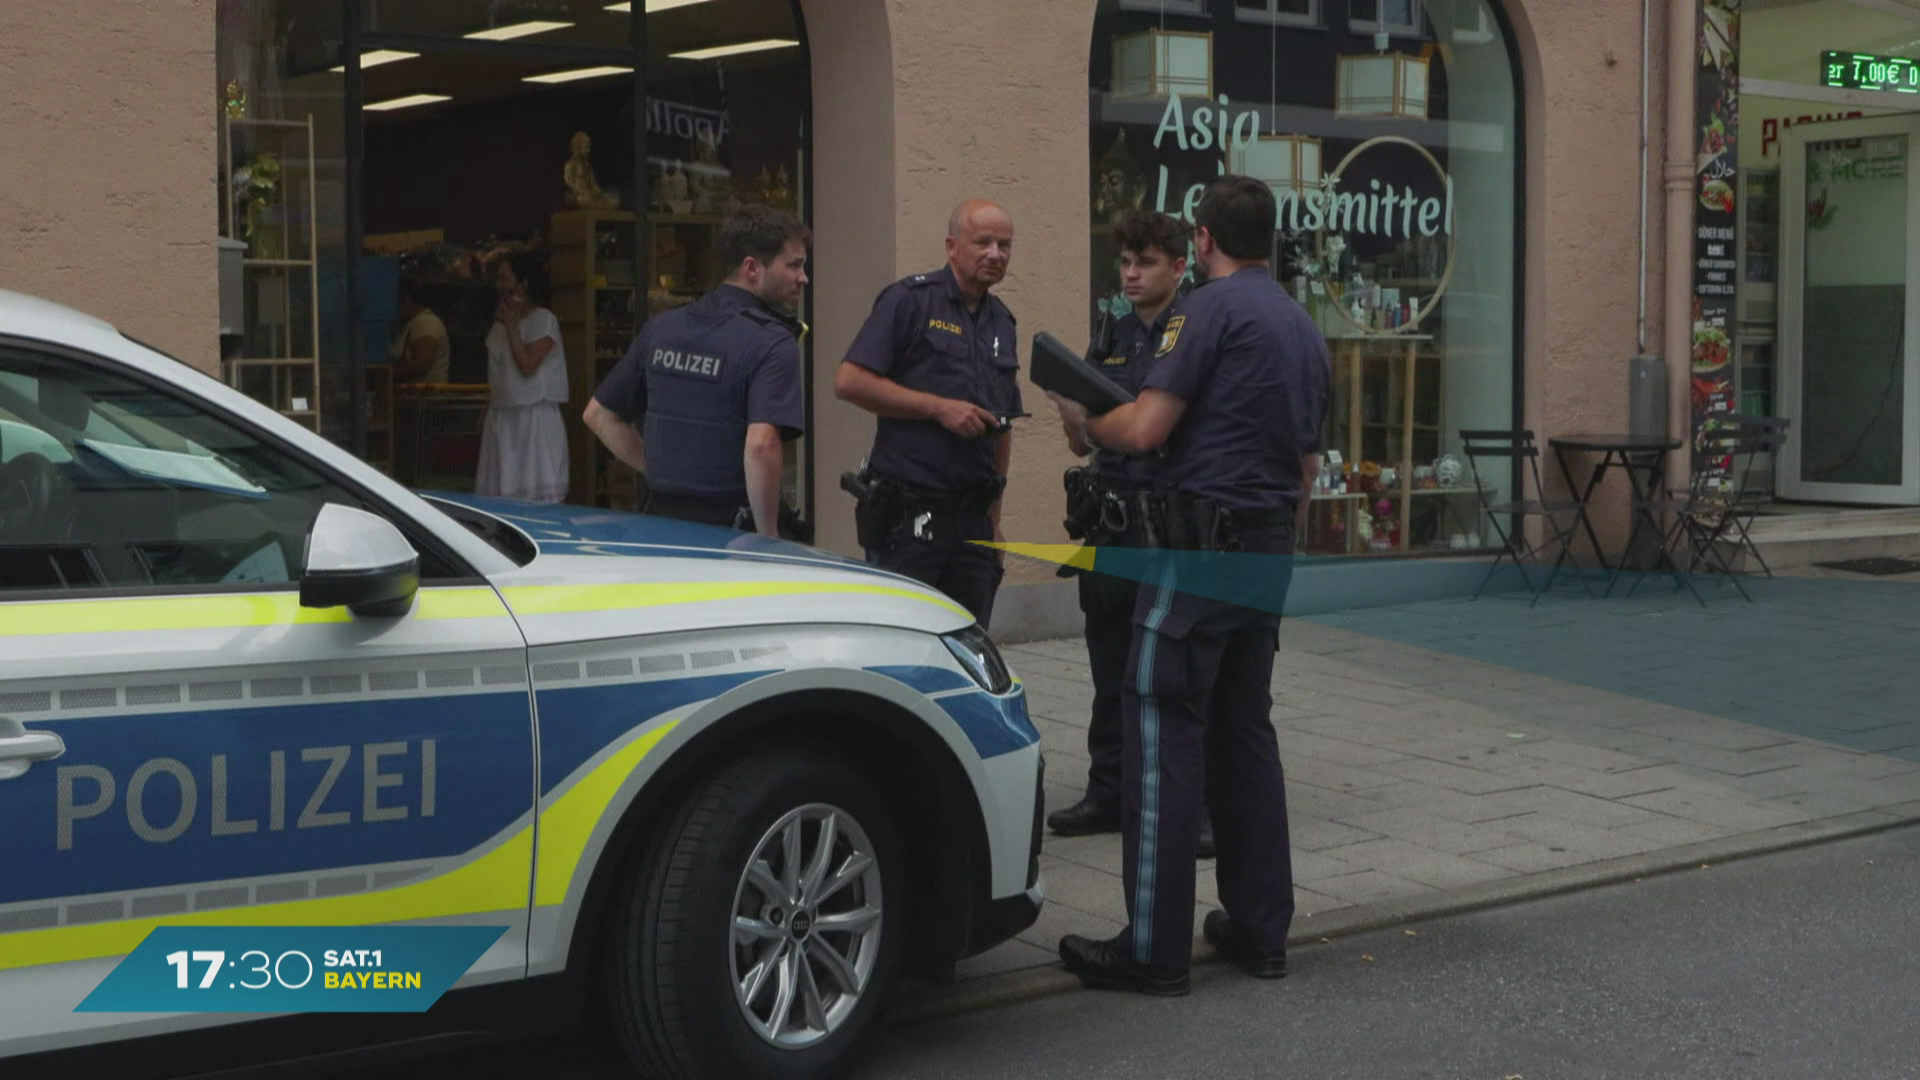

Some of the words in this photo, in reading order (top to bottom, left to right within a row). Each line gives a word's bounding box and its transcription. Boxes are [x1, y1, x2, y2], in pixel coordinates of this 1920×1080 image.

[1853, 61, 1900, 84] 7,00€
[1154, 93, 1260, 151] Asia
[1156, 160, 1454, 239] Lensmittel
[929, 319, 963, 336] POLIZEI
[652, 349, 721, 378] POLIZEI
[56, 739, 438, 851] POLIZEI
